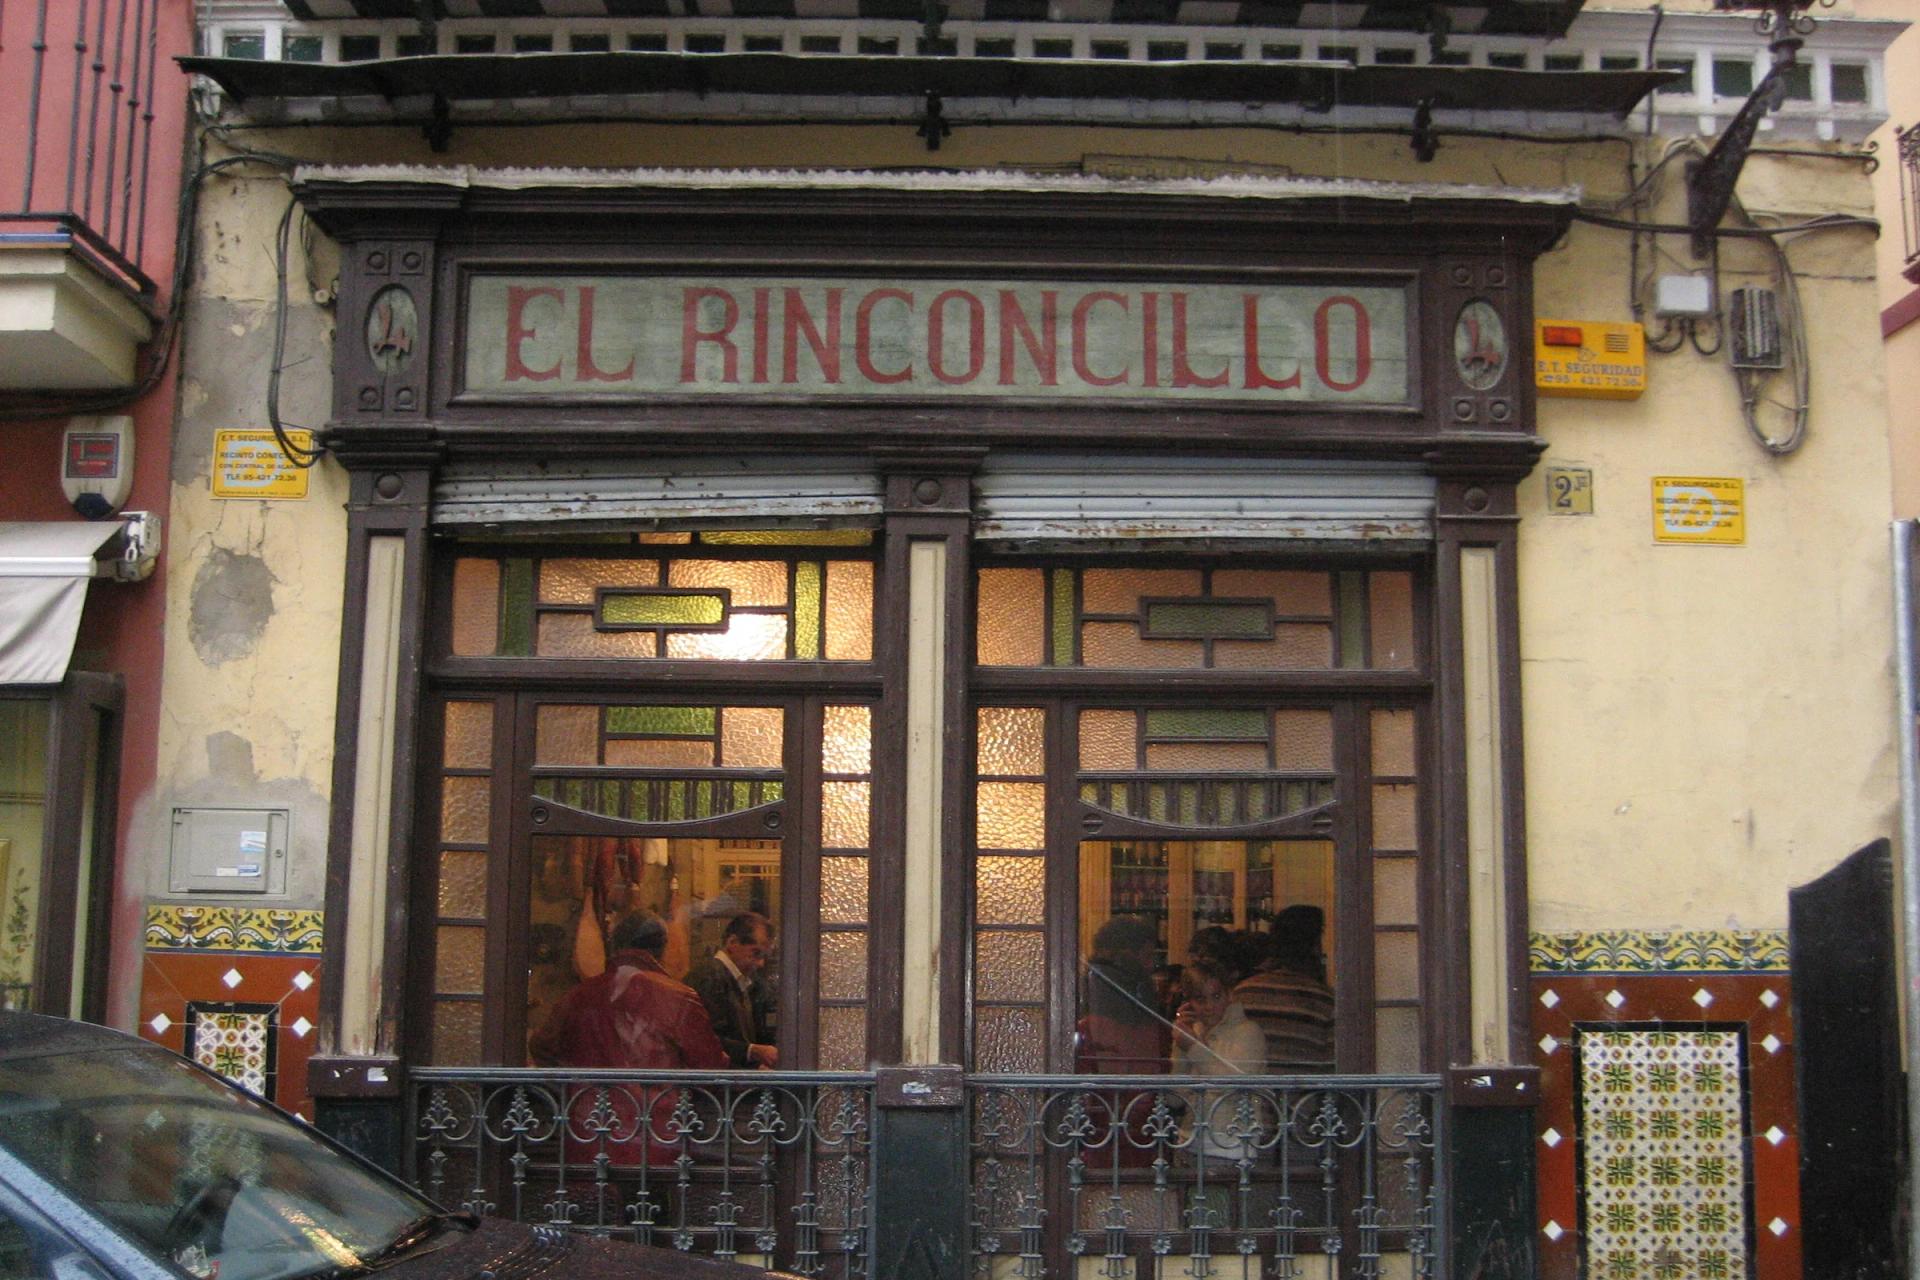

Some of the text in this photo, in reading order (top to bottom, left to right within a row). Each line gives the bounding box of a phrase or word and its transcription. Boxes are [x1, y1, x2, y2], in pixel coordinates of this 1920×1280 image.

[505, 285, 1371, 392] EL RINCONCILLO
[1566, 362, 1642, 377] SEGURIDAD
